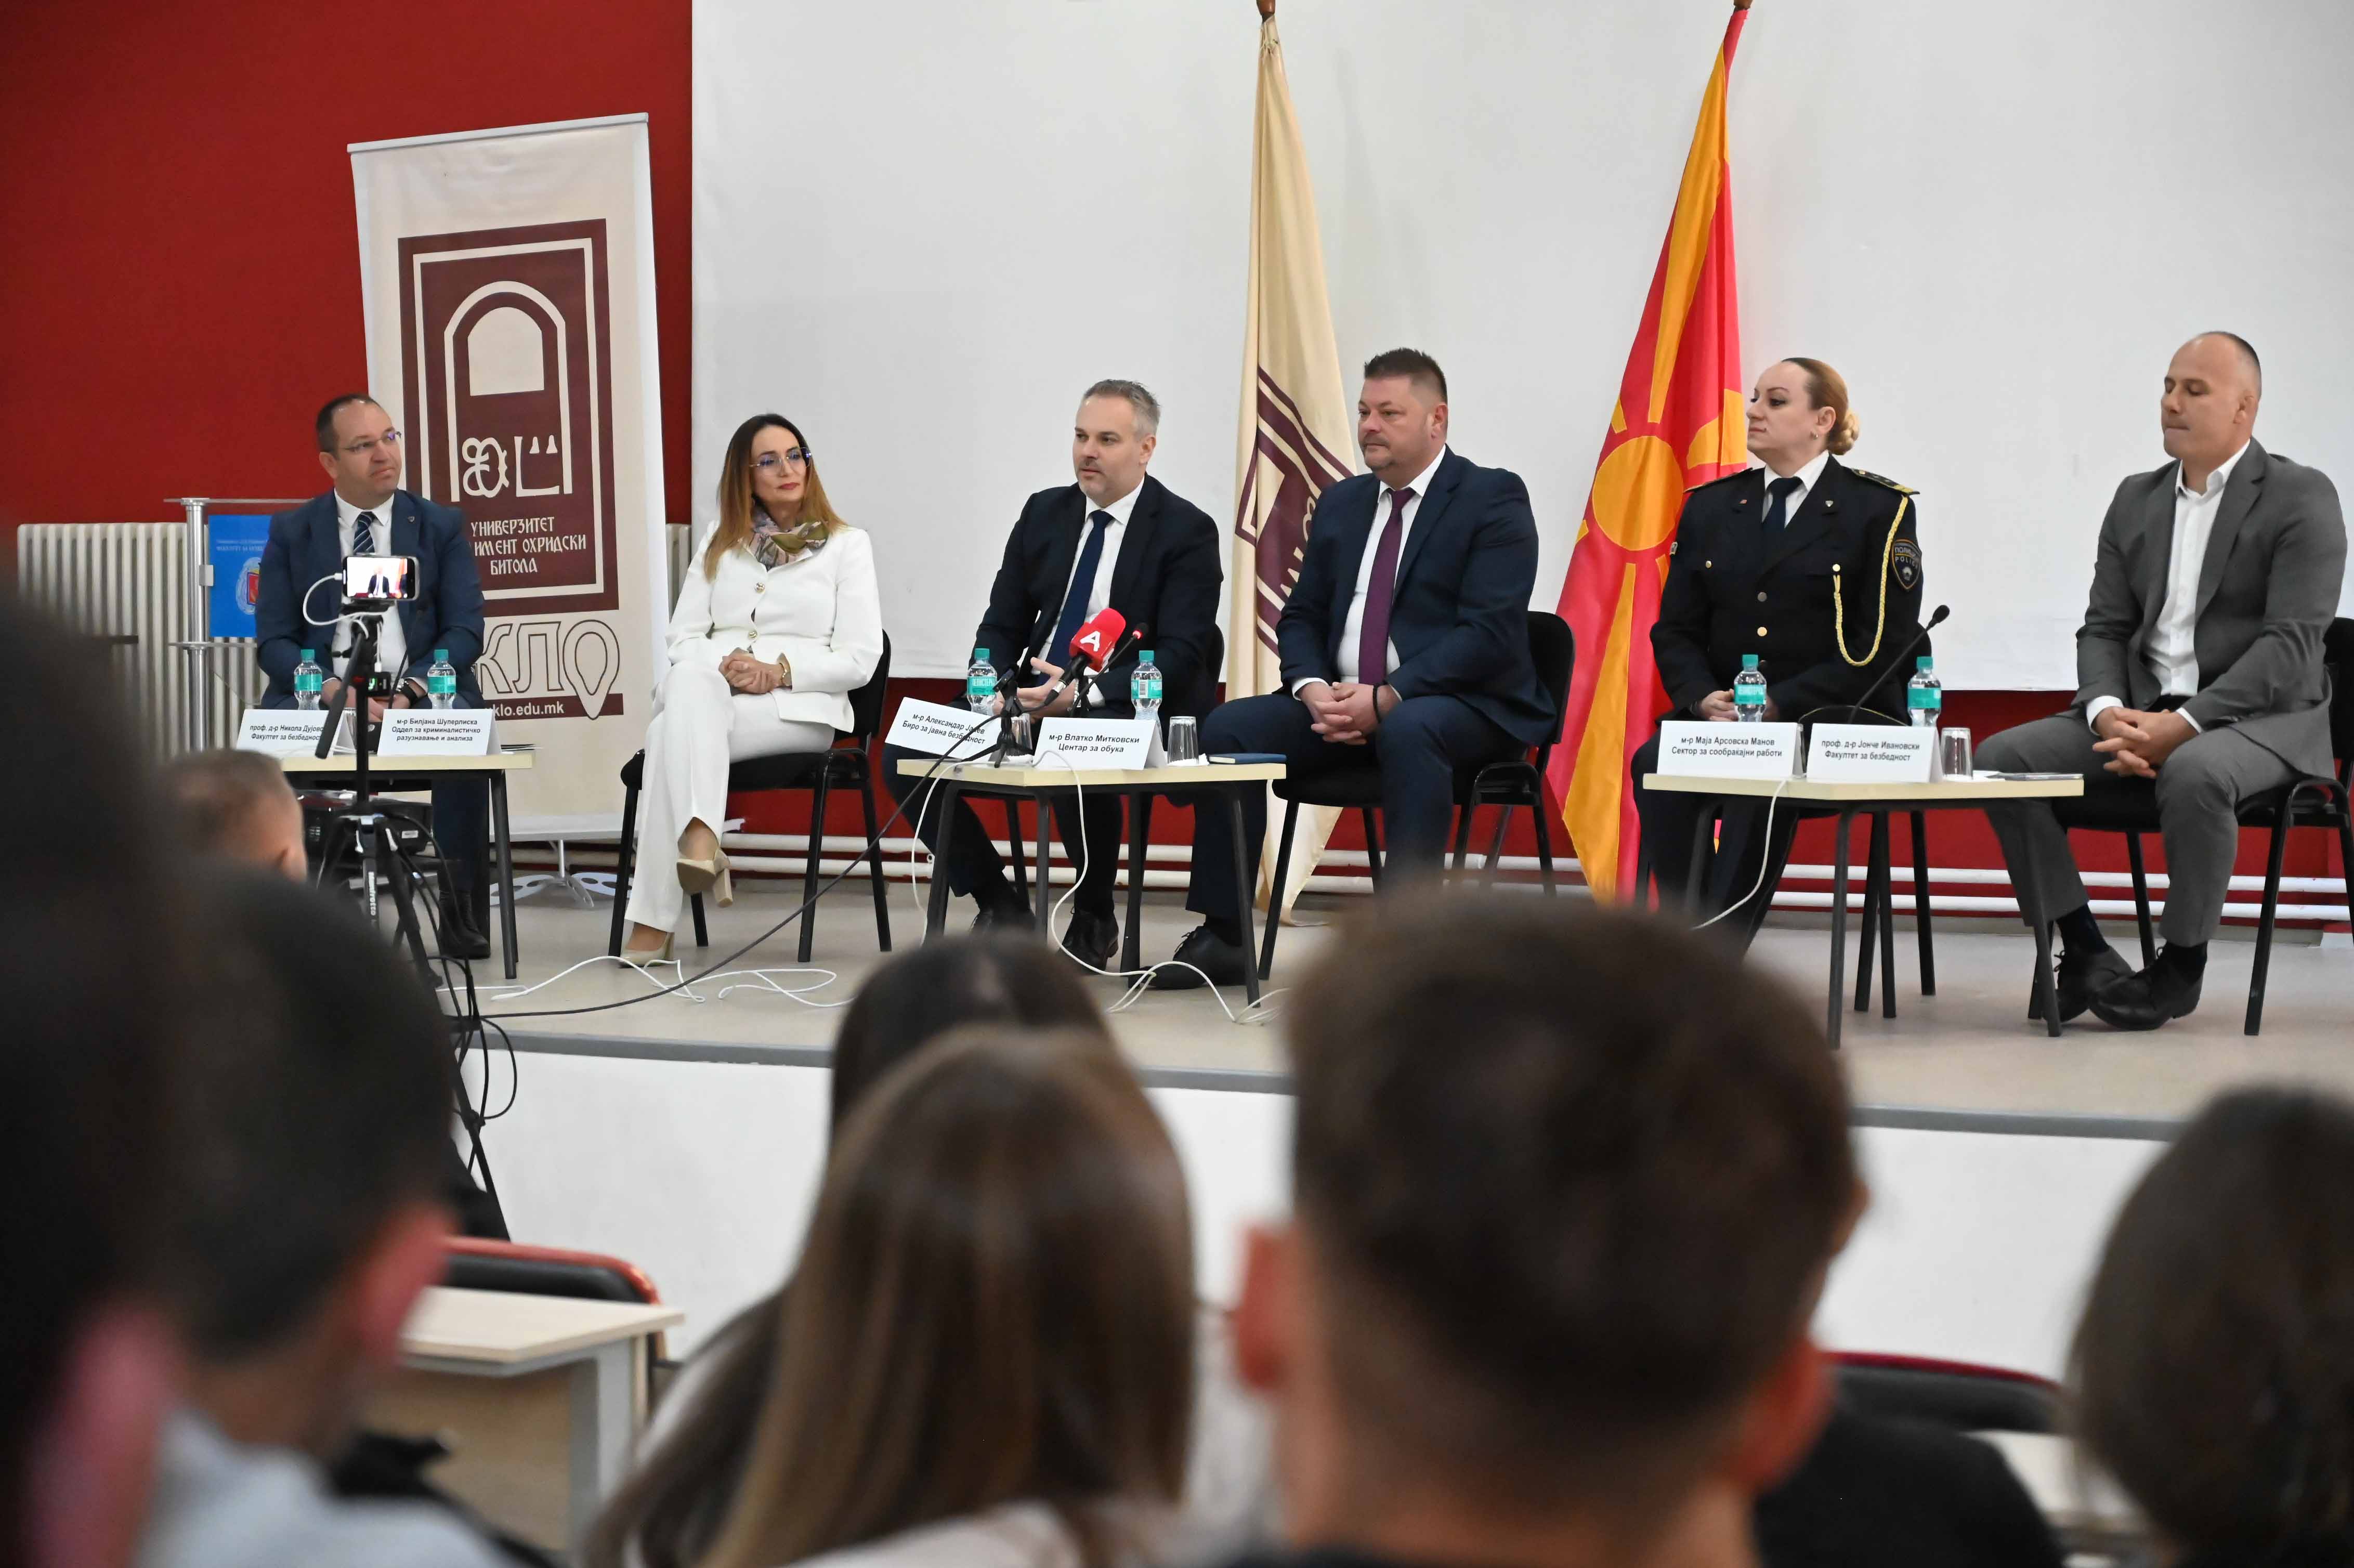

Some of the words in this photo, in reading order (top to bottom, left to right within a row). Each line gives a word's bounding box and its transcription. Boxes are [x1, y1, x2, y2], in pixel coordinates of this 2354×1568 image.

[470, 516, 555, 537] УНИВЕРЗИТЕТ
[474, 539, 518, 556] ИМЕНТ
[522, 534, 586, 553] ОХРИДСКИ
[490, 557, 538, 575] БИТОЛА
[470, 619, 620, 721] КЛО
[492, 701, 565, 717] klo.edu.mk
[250, 724, 267, 733] проф.
[912, 714, 924, 722] м-р
[926, 715, 964, 730] Александар
[965, 725, 985, 735] Јаев
[902, 721, 919, 730] Биро
[927, 726, 947, 736] јавна
[948, 731, 985, 744] безбдност
[1095, 735, 1140, 743] Митковски
[1058, 743, 1087, 752] Центар
[1695, 736, 1712, 746] Маја
[1714, 737, 1748, 746] Арсовска
[1751, 737, 1775, 746] Манов
[1858, 740, 1879, 749] Јонче
[1881, 741, 1920, 750] Ивановски
[1671, 746, 1697, 754] Сектор
[1757, 749, 1782, 757] работи
[1825, 750, 1858, 760] Факултет
[1869, 752, 1911, 761] безбедност
